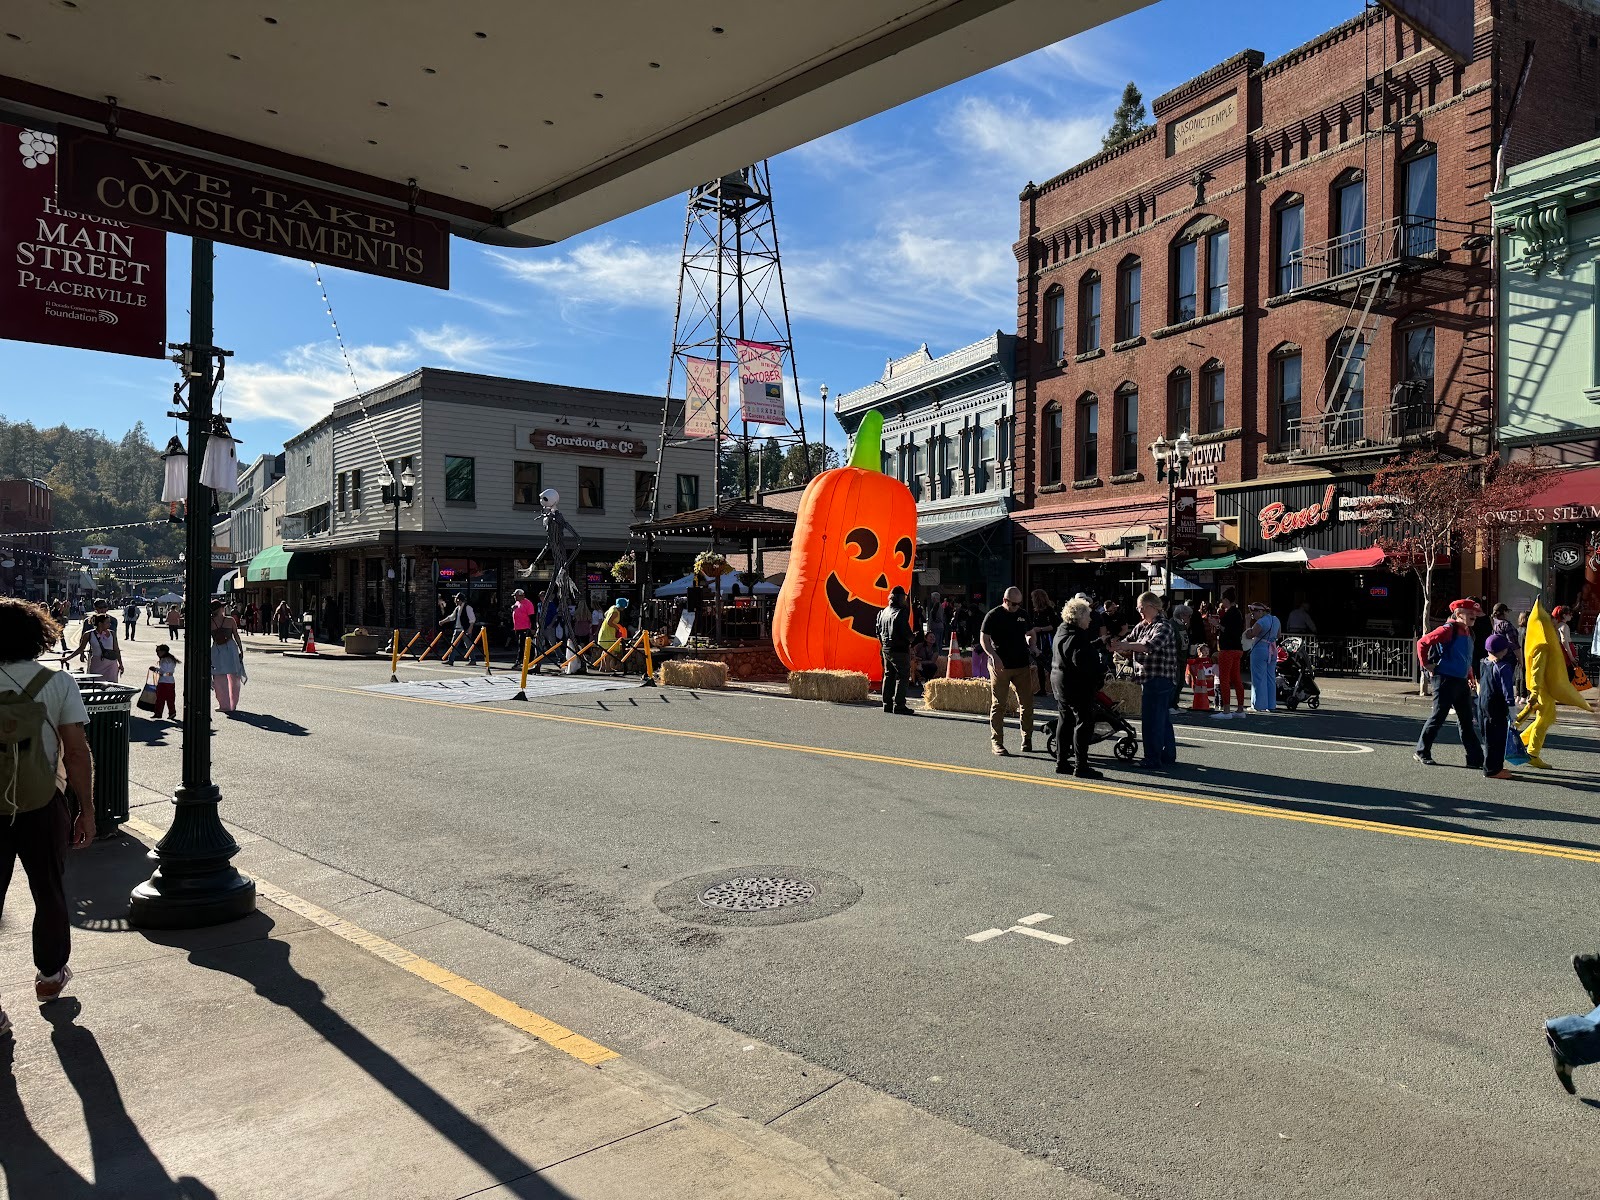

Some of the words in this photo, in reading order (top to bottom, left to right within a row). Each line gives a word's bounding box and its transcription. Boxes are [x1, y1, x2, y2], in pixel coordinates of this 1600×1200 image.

[132, 157, 232, 199] WE
[251, 187, 396, 239] TAKE
[96, 176, 425, 275] CONSIGNMENTS
[36, 218, 134, 258] MAIN
[16, 242, 150, 285] STREET
[17, 270, 148, 307] PLACERVILLE
[45, 307, 98, 323] Foundation
[742, 370, 782, 384] OCTOBER
[546, 433, 609, 450] Sourdough
[610, 442, 618, 450] &
[1191, 443, 1224, 466] TOWN
[1173, 465, 1215, 488] NTRE
[1258, 483, 1336, 540] Bene!
[1478, 508, 1545, 524] OWELL'S
[1553, 550, 1578, 561] 805
